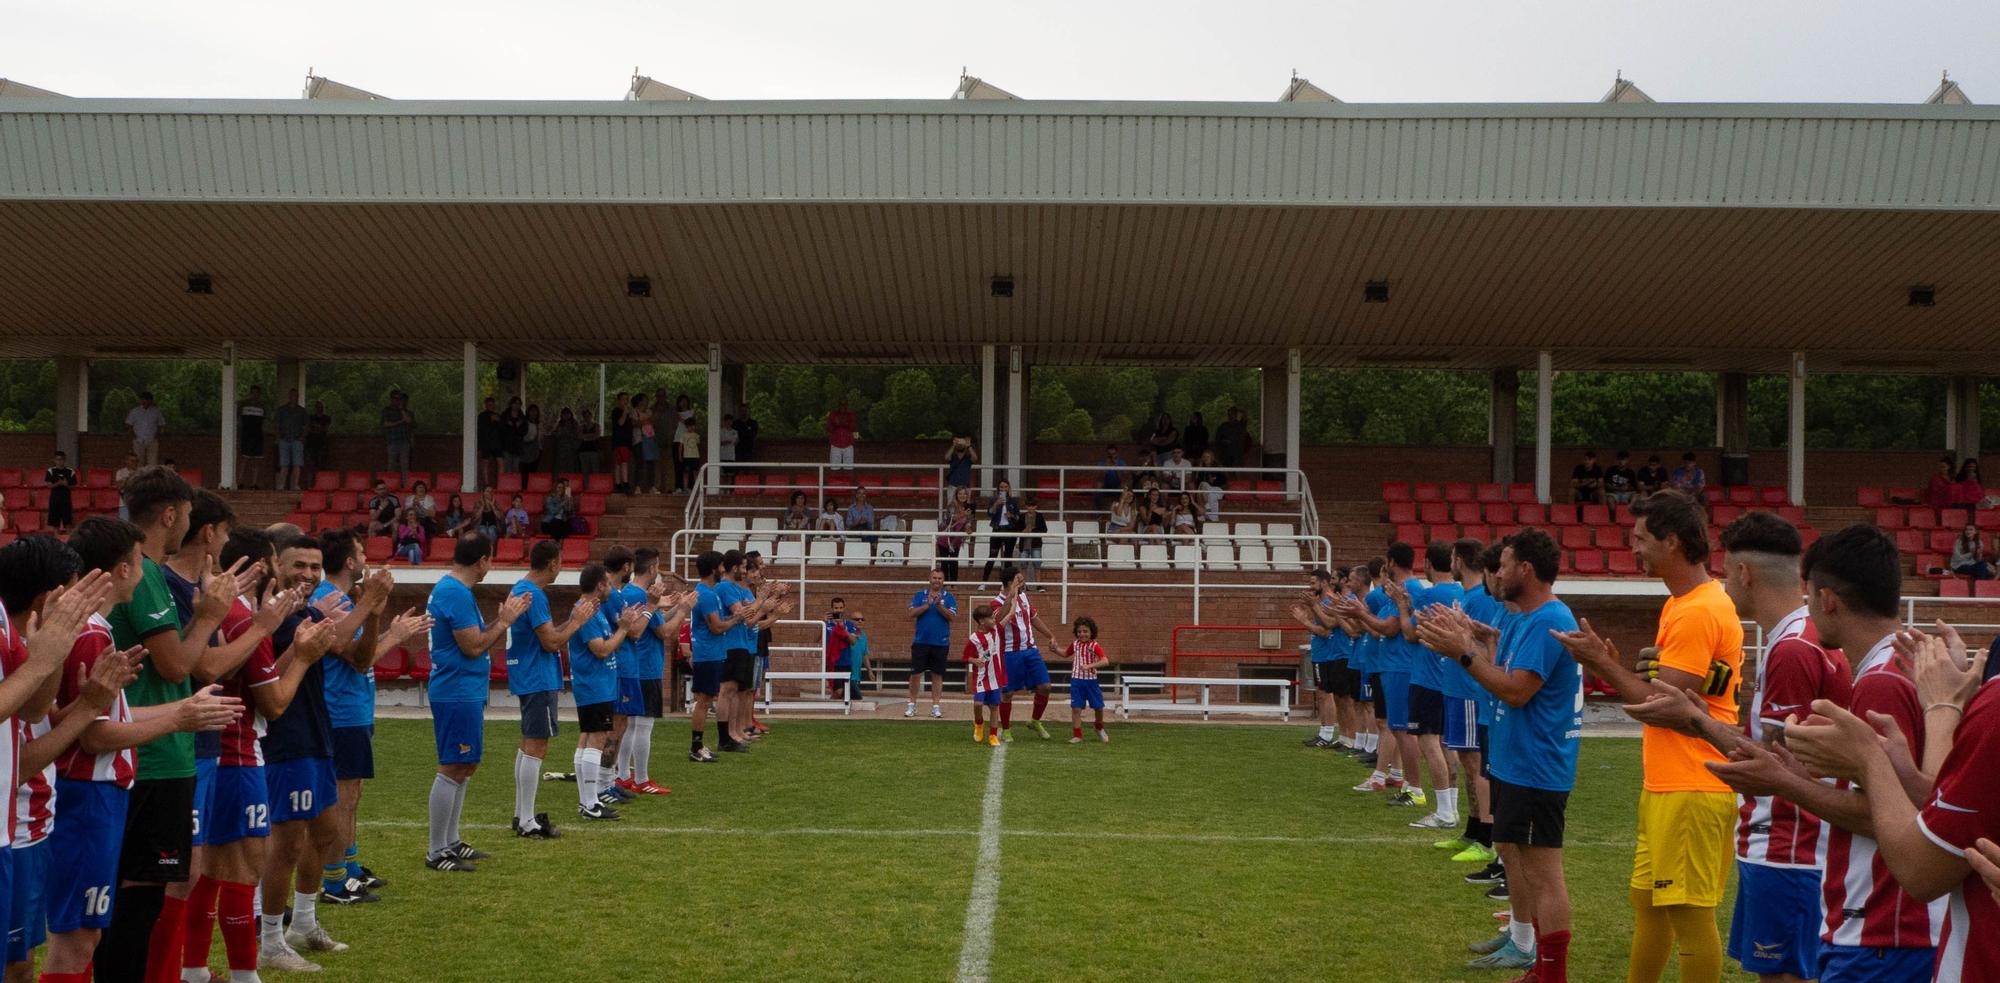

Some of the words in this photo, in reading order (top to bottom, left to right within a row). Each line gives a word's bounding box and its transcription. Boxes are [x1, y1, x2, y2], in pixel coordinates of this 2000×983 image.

[289, 789, 313, 812] 10
[245, 803, 267, 829] 12
[1654, 879, 1673, 889] SP
[84, 885, 111, 916] 16
[1753, 950, 1784, 961] ONZE
